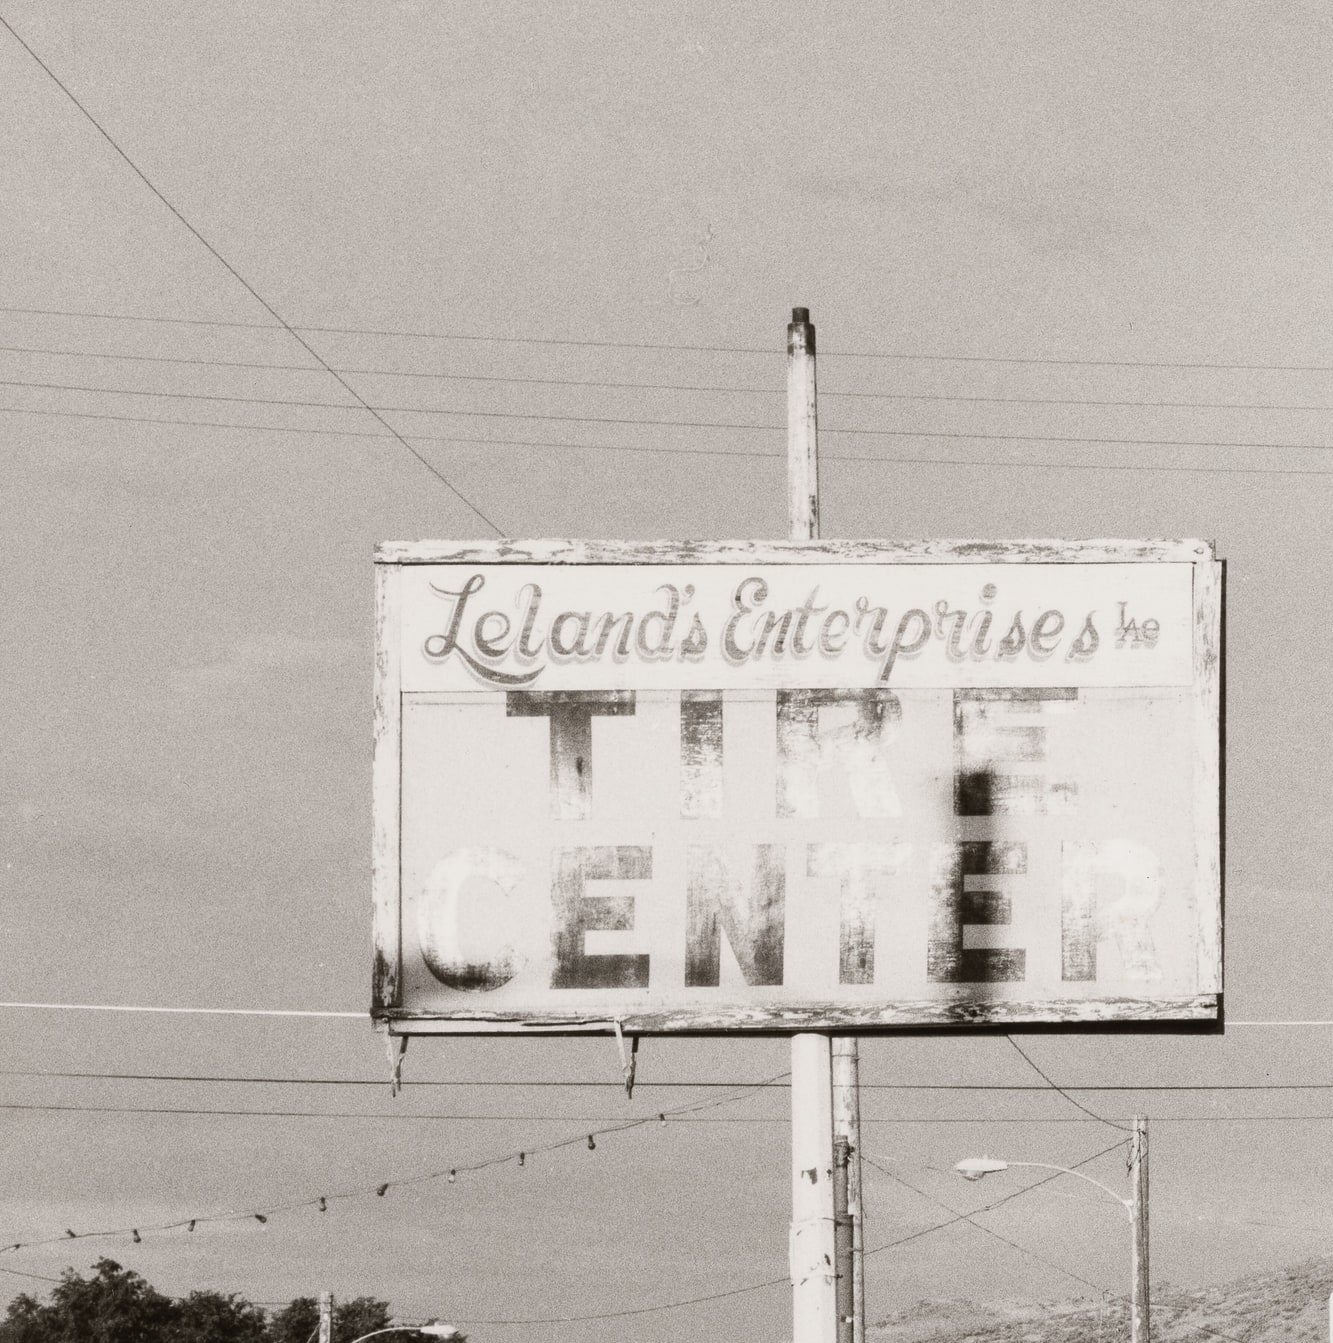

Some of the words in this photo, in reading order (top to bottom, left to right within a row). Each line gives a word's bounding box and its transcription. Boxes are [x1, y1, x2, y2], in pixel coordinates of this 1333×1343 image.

[422, 573, 708, 687] Leland's
[722, 575, 1101, 682] Enterprises
[506, 687, 1079, 821] TIRE
[417, 840, 1167, 992] CENTER
